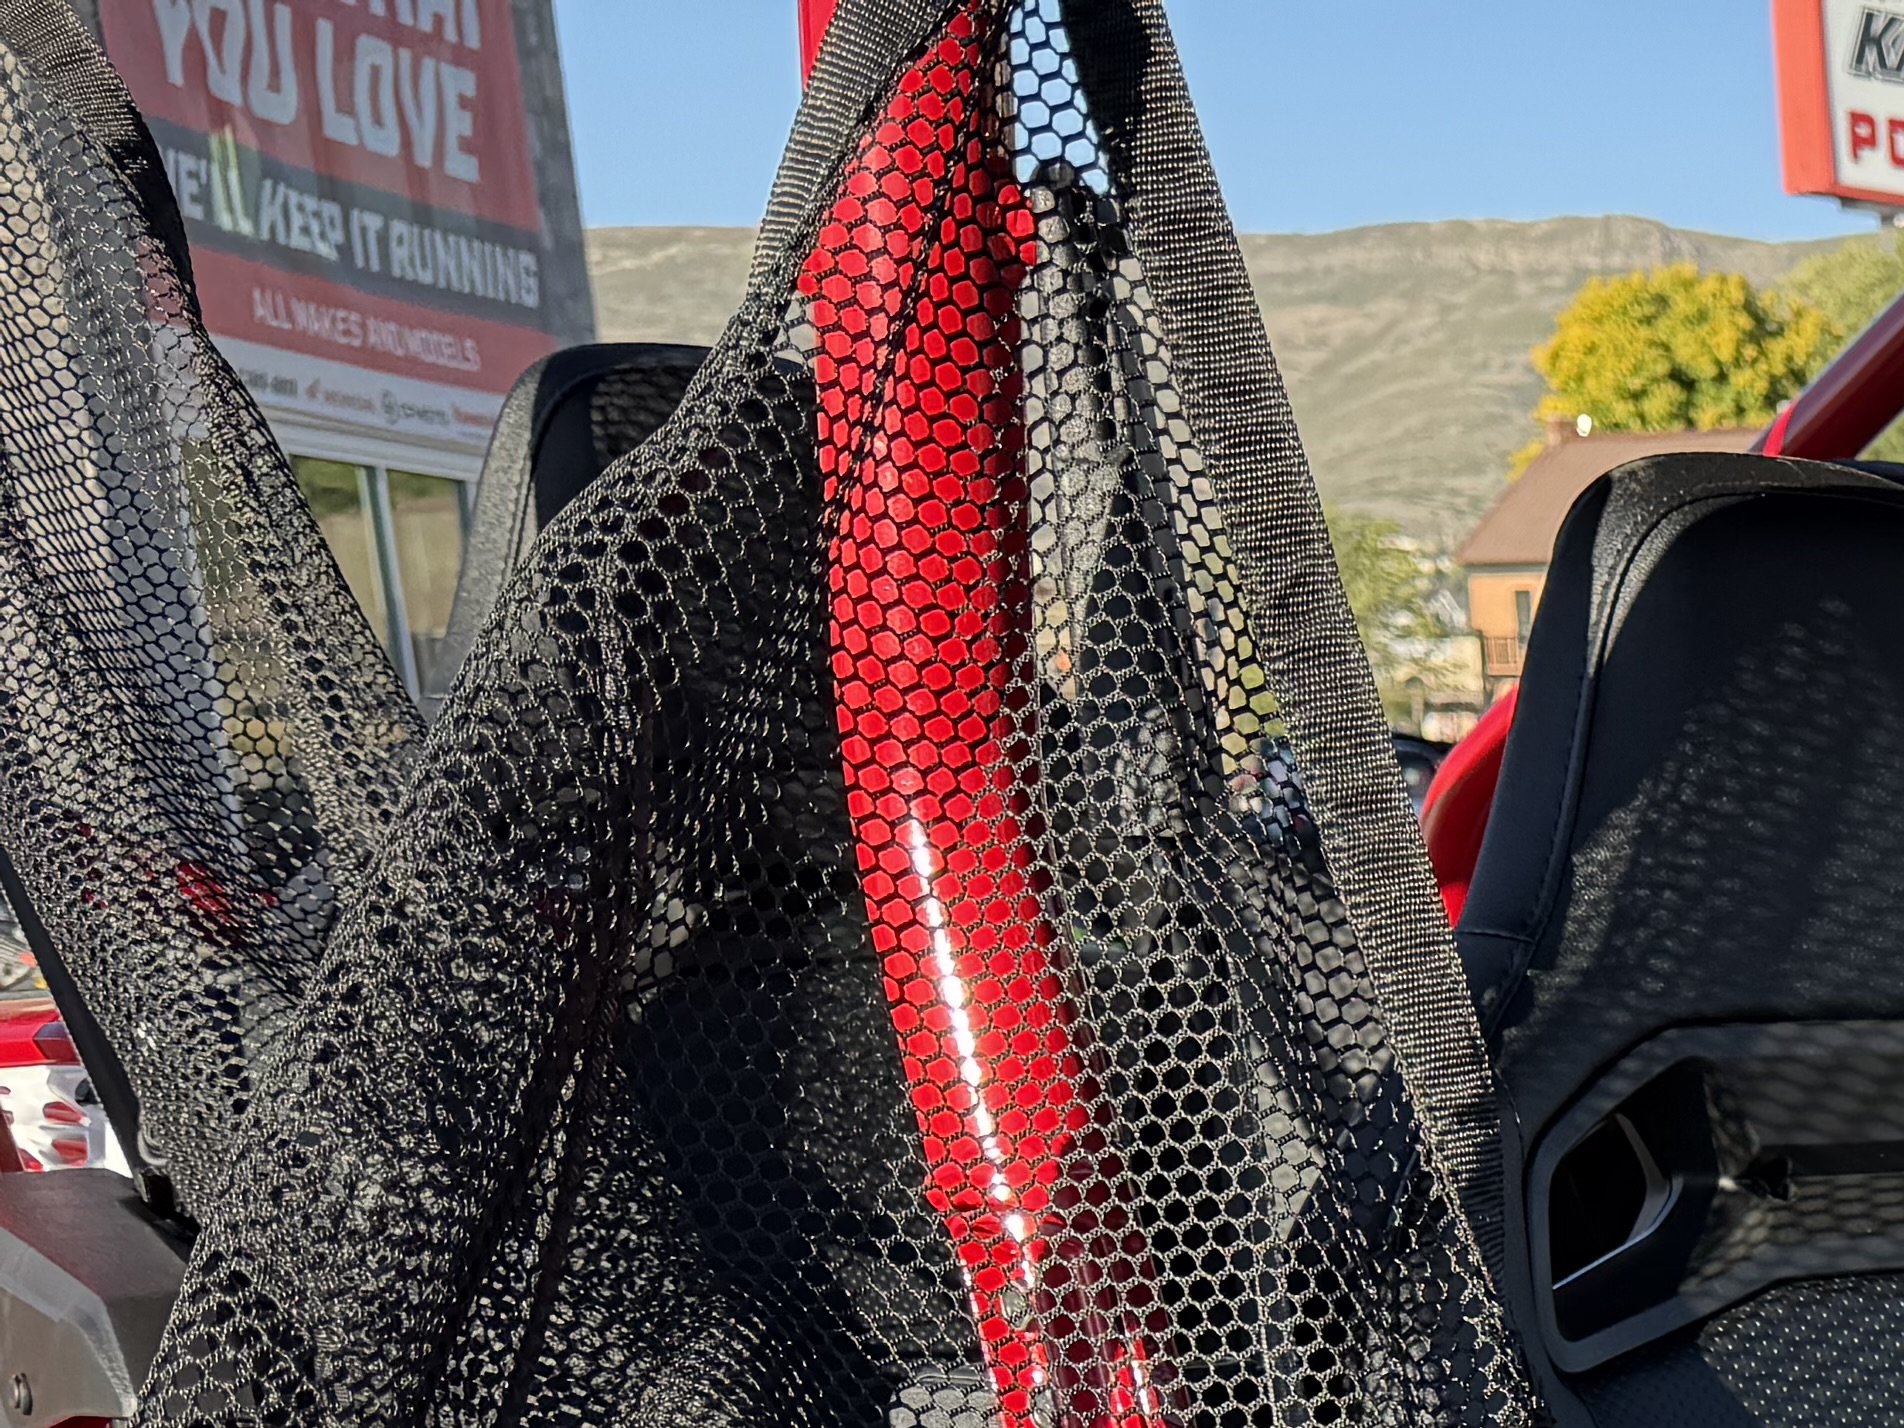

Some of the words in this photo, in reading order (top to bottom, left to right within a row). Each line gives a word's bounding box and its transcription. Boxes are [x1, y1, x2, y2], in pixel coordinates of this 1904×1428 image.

[155, 0, 298, 126] YOU
[315, 17, 480, 184] LOVE
[257, 177, 344, 262] KEEP
[349, 206, 385, 273] IT
[388, 217, 541, 310] RUNNING
[252, 286, 292, 330] ALL
[291, 299, 363, 348] MAKES
[365, 315, 405, 358] AND
[404, 322, 481, 373] MODELS
